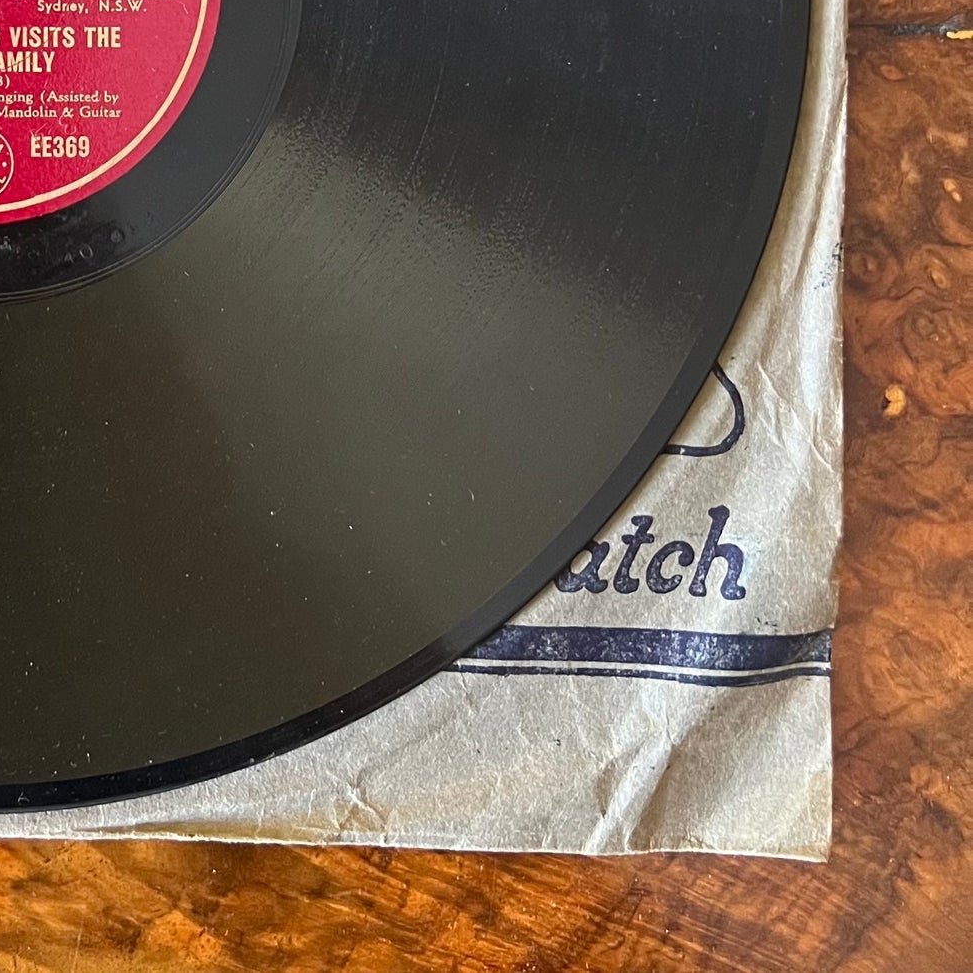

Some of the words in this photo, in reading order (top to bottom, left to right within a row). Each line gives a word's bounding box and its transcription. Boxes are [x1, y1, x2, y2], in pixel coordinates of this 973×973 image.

[37, 0, 89, 15] Sydney,
[98, 0, 147, 13] N.S.W.
[10, 26, 76, 48] VISITS
[84, 26, 121, 48] THE
[40, 90, 100, 104] (Assisted
[103, 91, 119, 105] by
[62, 107, 75, 118] &
[79, 107, 122, 118] Guitar
[30, 134, 90, 158] EE369
[554, 504, 747, 601] atch
